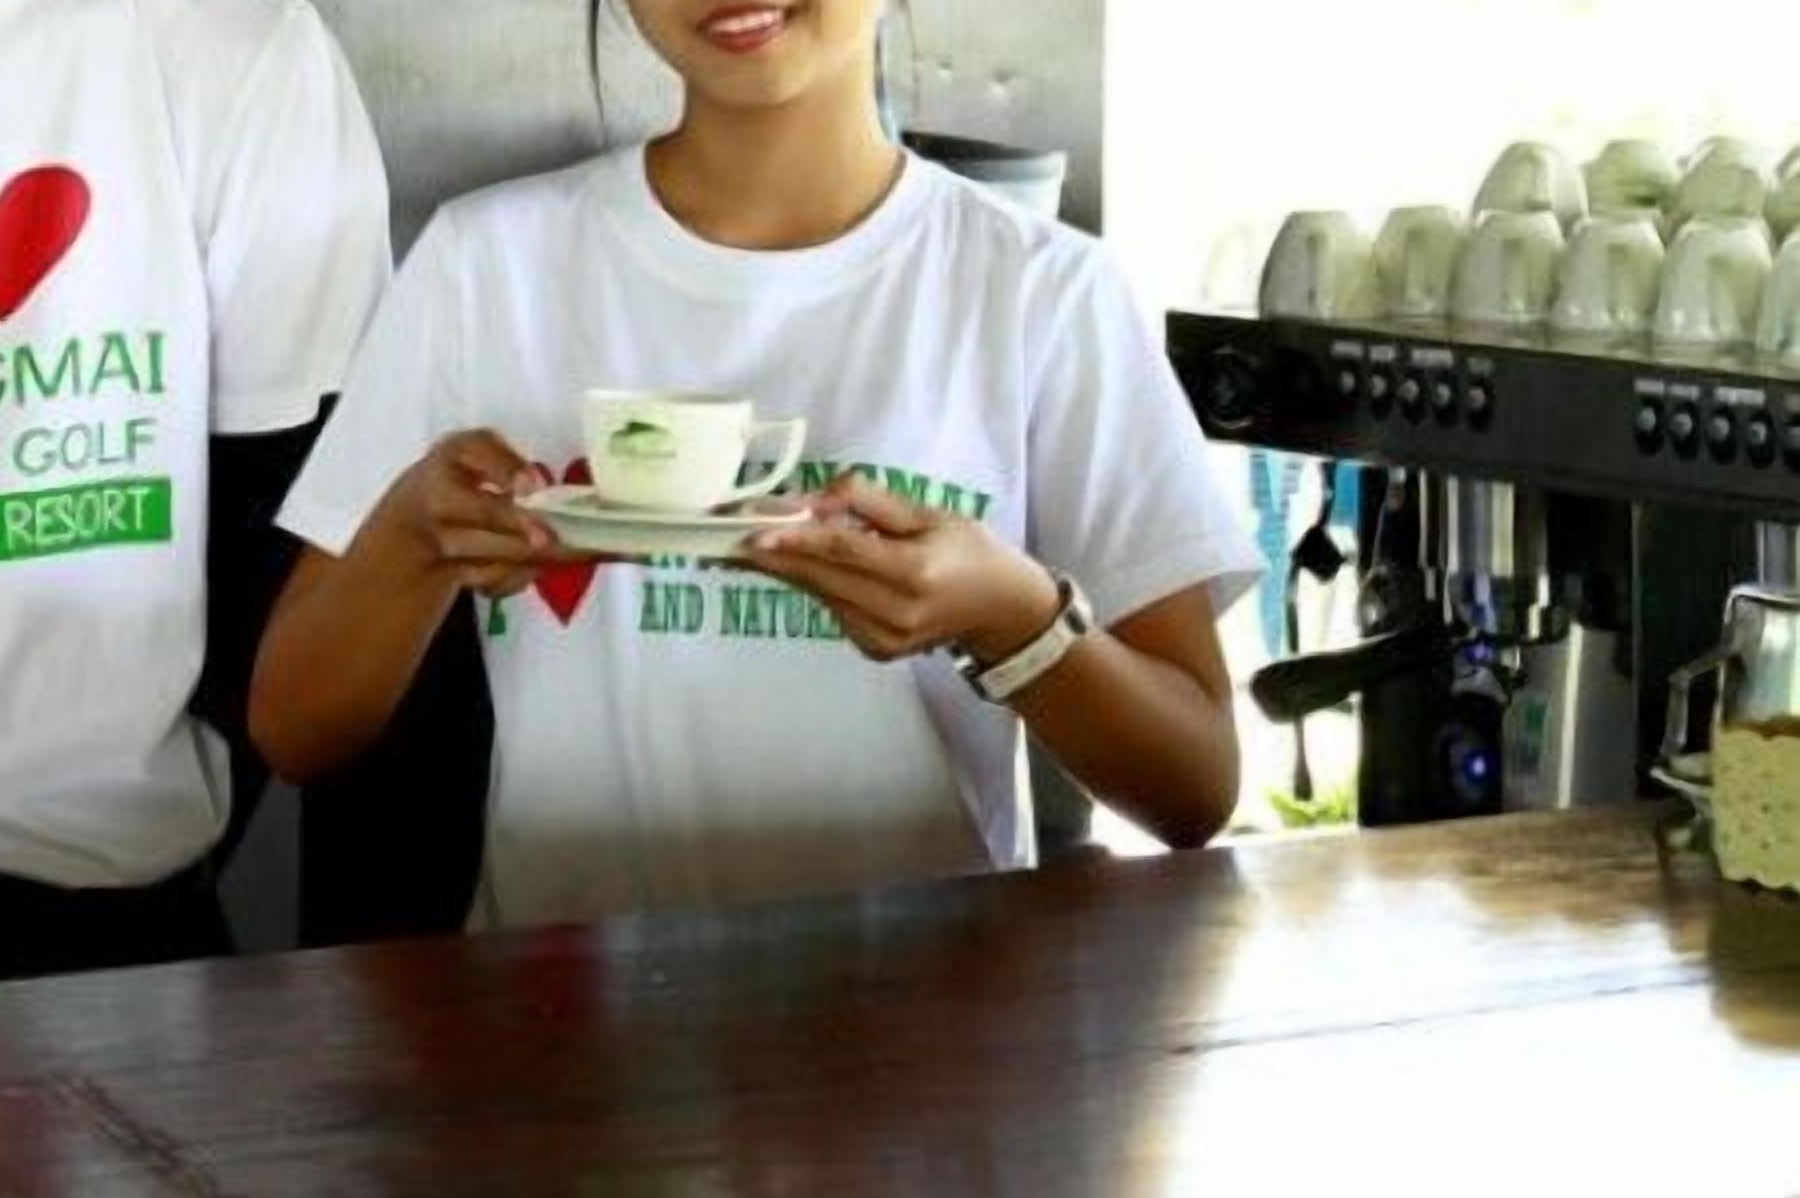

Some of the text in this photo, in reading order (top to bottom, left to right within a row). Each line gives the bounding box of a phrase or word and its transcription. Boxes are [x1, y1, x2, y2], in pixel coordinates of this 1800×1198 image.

[12, 418, 157, 477] GOLF
[4, 486, 151, 548] RESORT
[639, 580, 705, 634] AND
